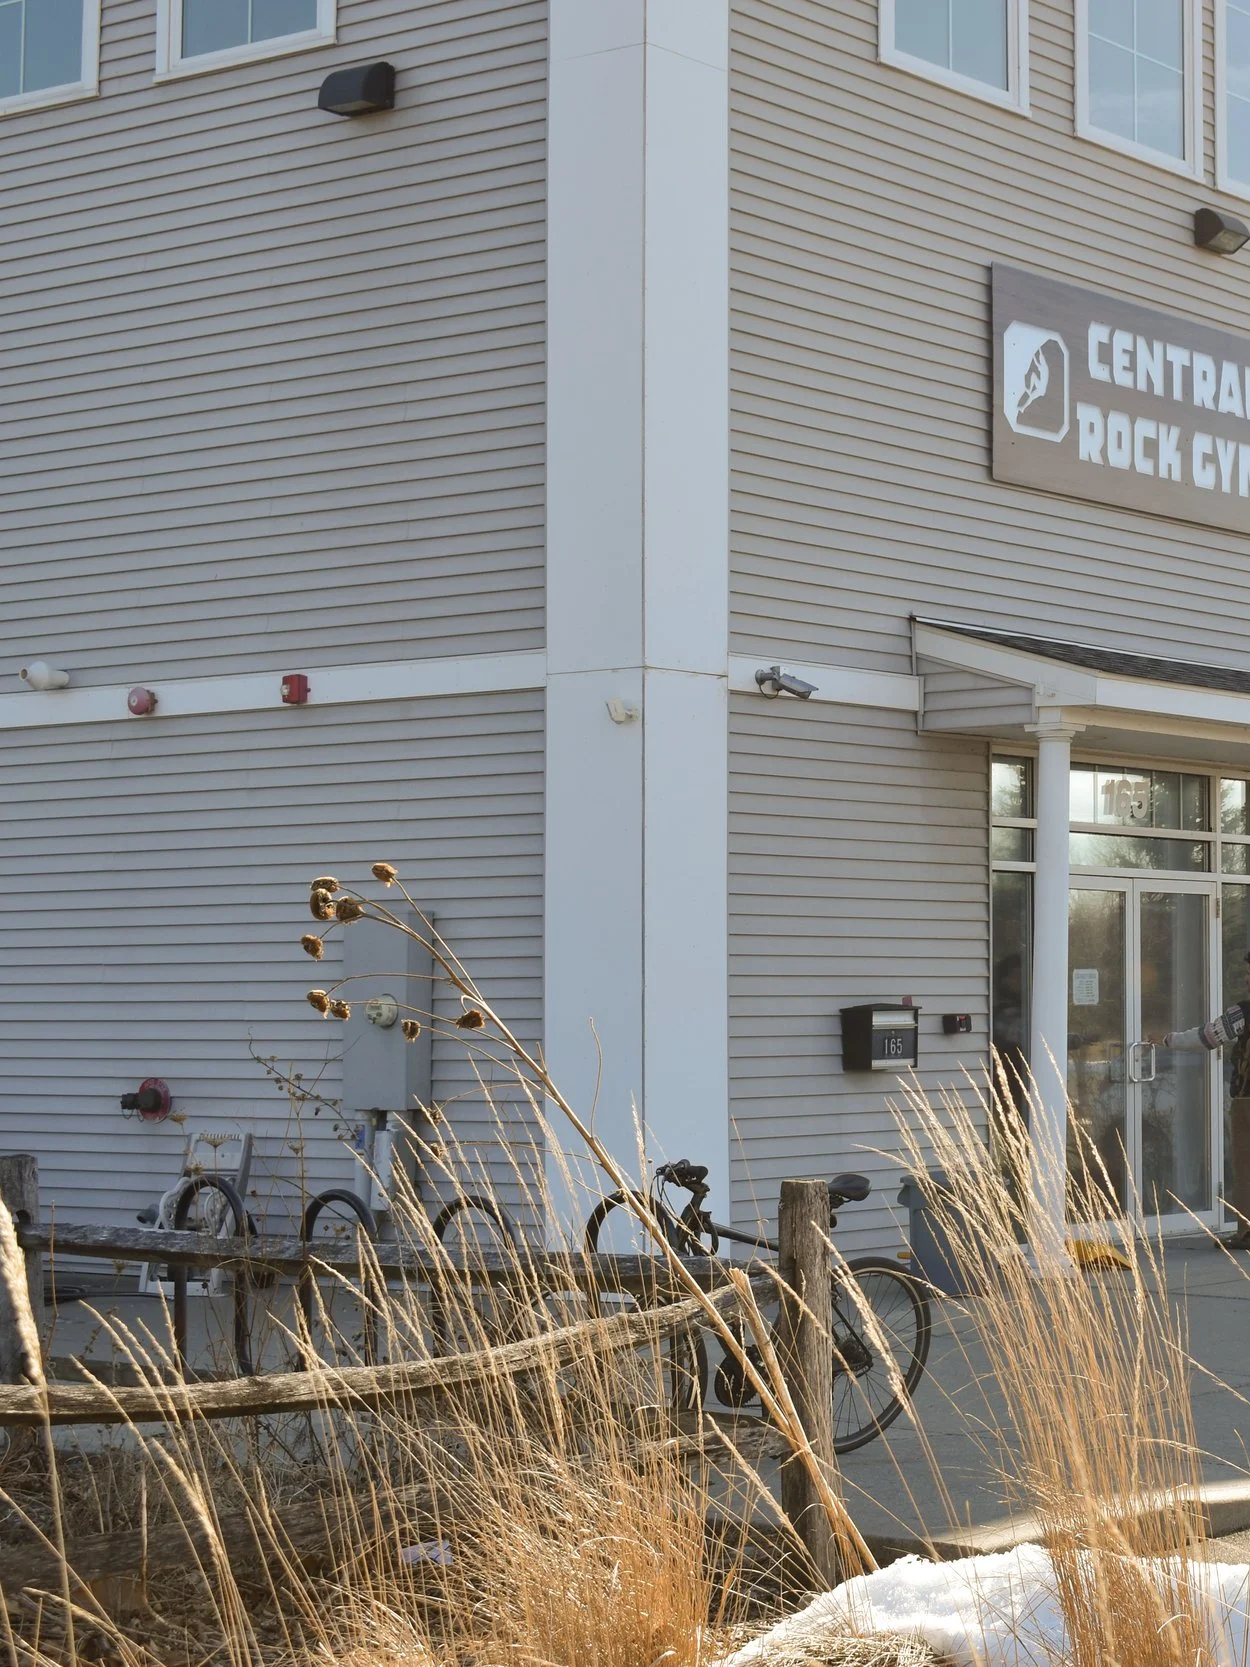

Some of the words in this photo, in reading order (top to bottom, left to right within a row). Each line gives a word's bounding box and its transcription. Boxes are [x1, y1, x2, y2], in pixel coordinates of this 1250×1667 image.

[1076, 401, 1182, 482] ROCK
[1102, 779, 1149, 819] 165
[885, 1039, 902, 1054] 165
